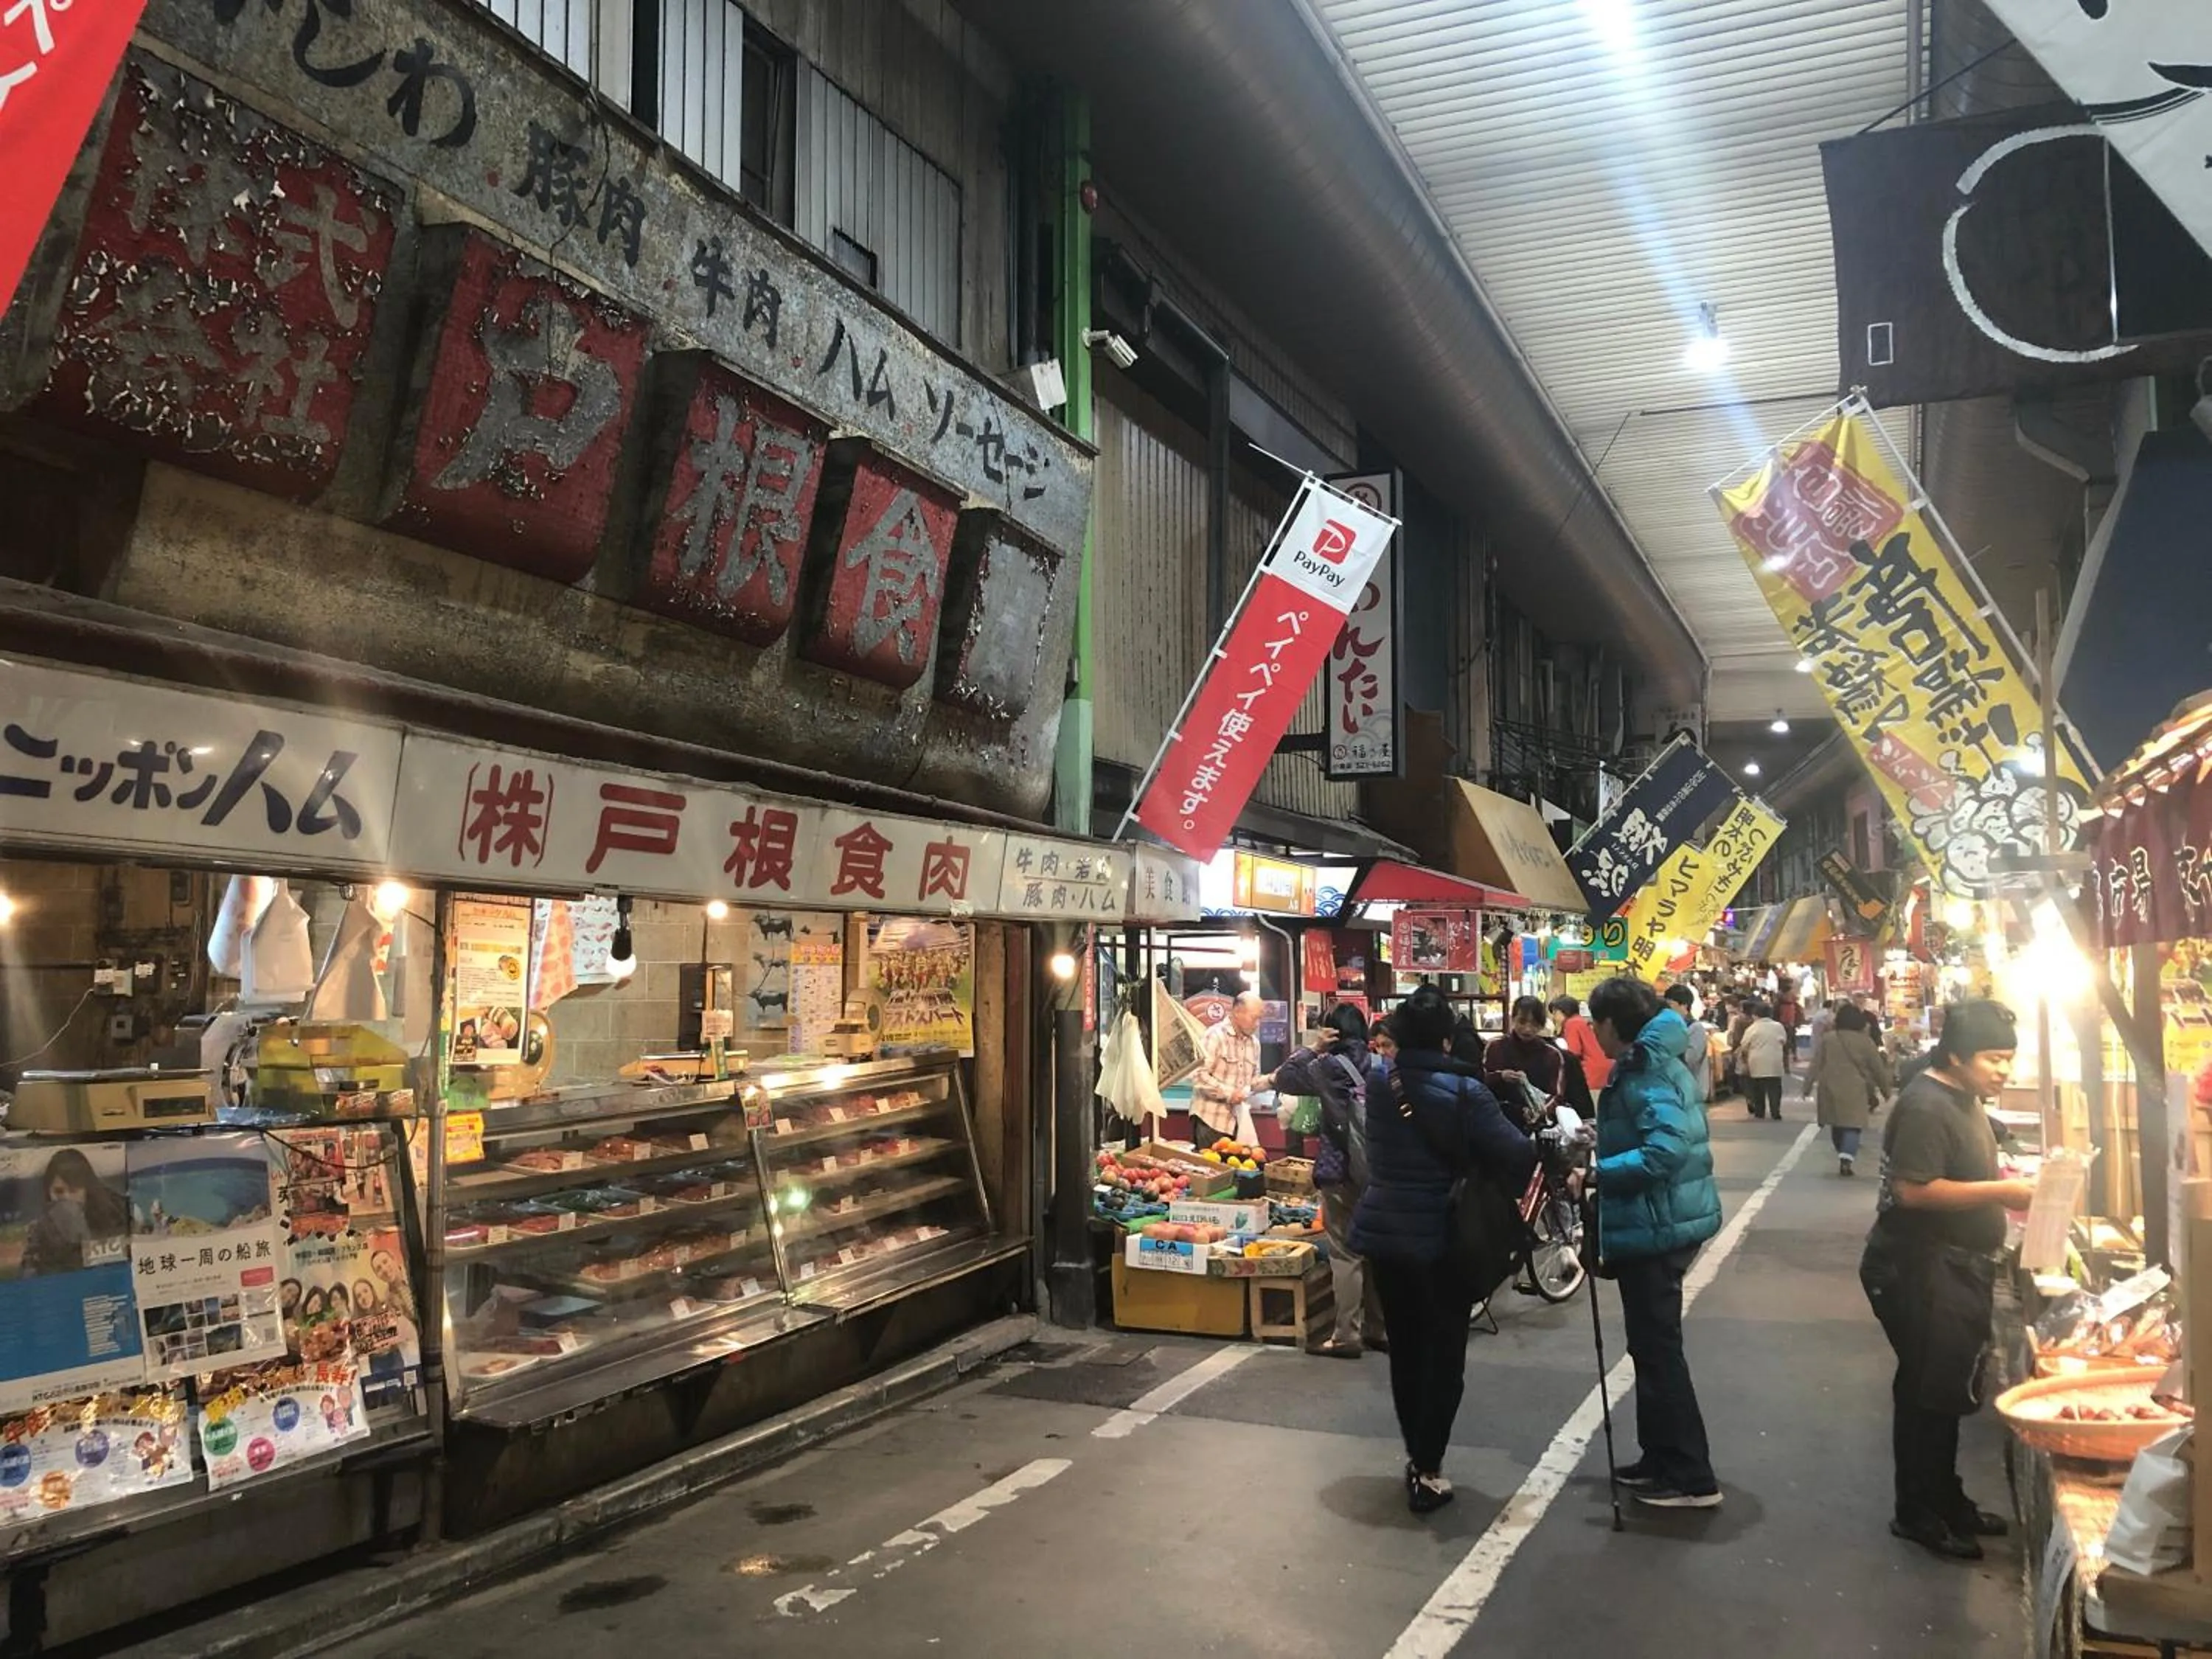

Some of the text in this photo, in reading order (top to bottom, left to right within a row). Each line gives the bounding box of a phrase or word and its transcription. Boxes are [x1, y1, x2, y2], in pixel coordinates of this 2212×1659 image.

[514, 120, 646, 267] 豚肉
[690, 235, 783, 348] 牛肉
[816, 318, 895, 422] ハム
[924, 377, 1051, 500] ソーセージ
[1293, 550, 1346, 588] PayPay
[1179, 610, 1310, 830] ペイペイ使えます。
[0, 723, 362, 839] ニッポンハム
[137, 1238, 273, 1276] 地球一周の船旅
